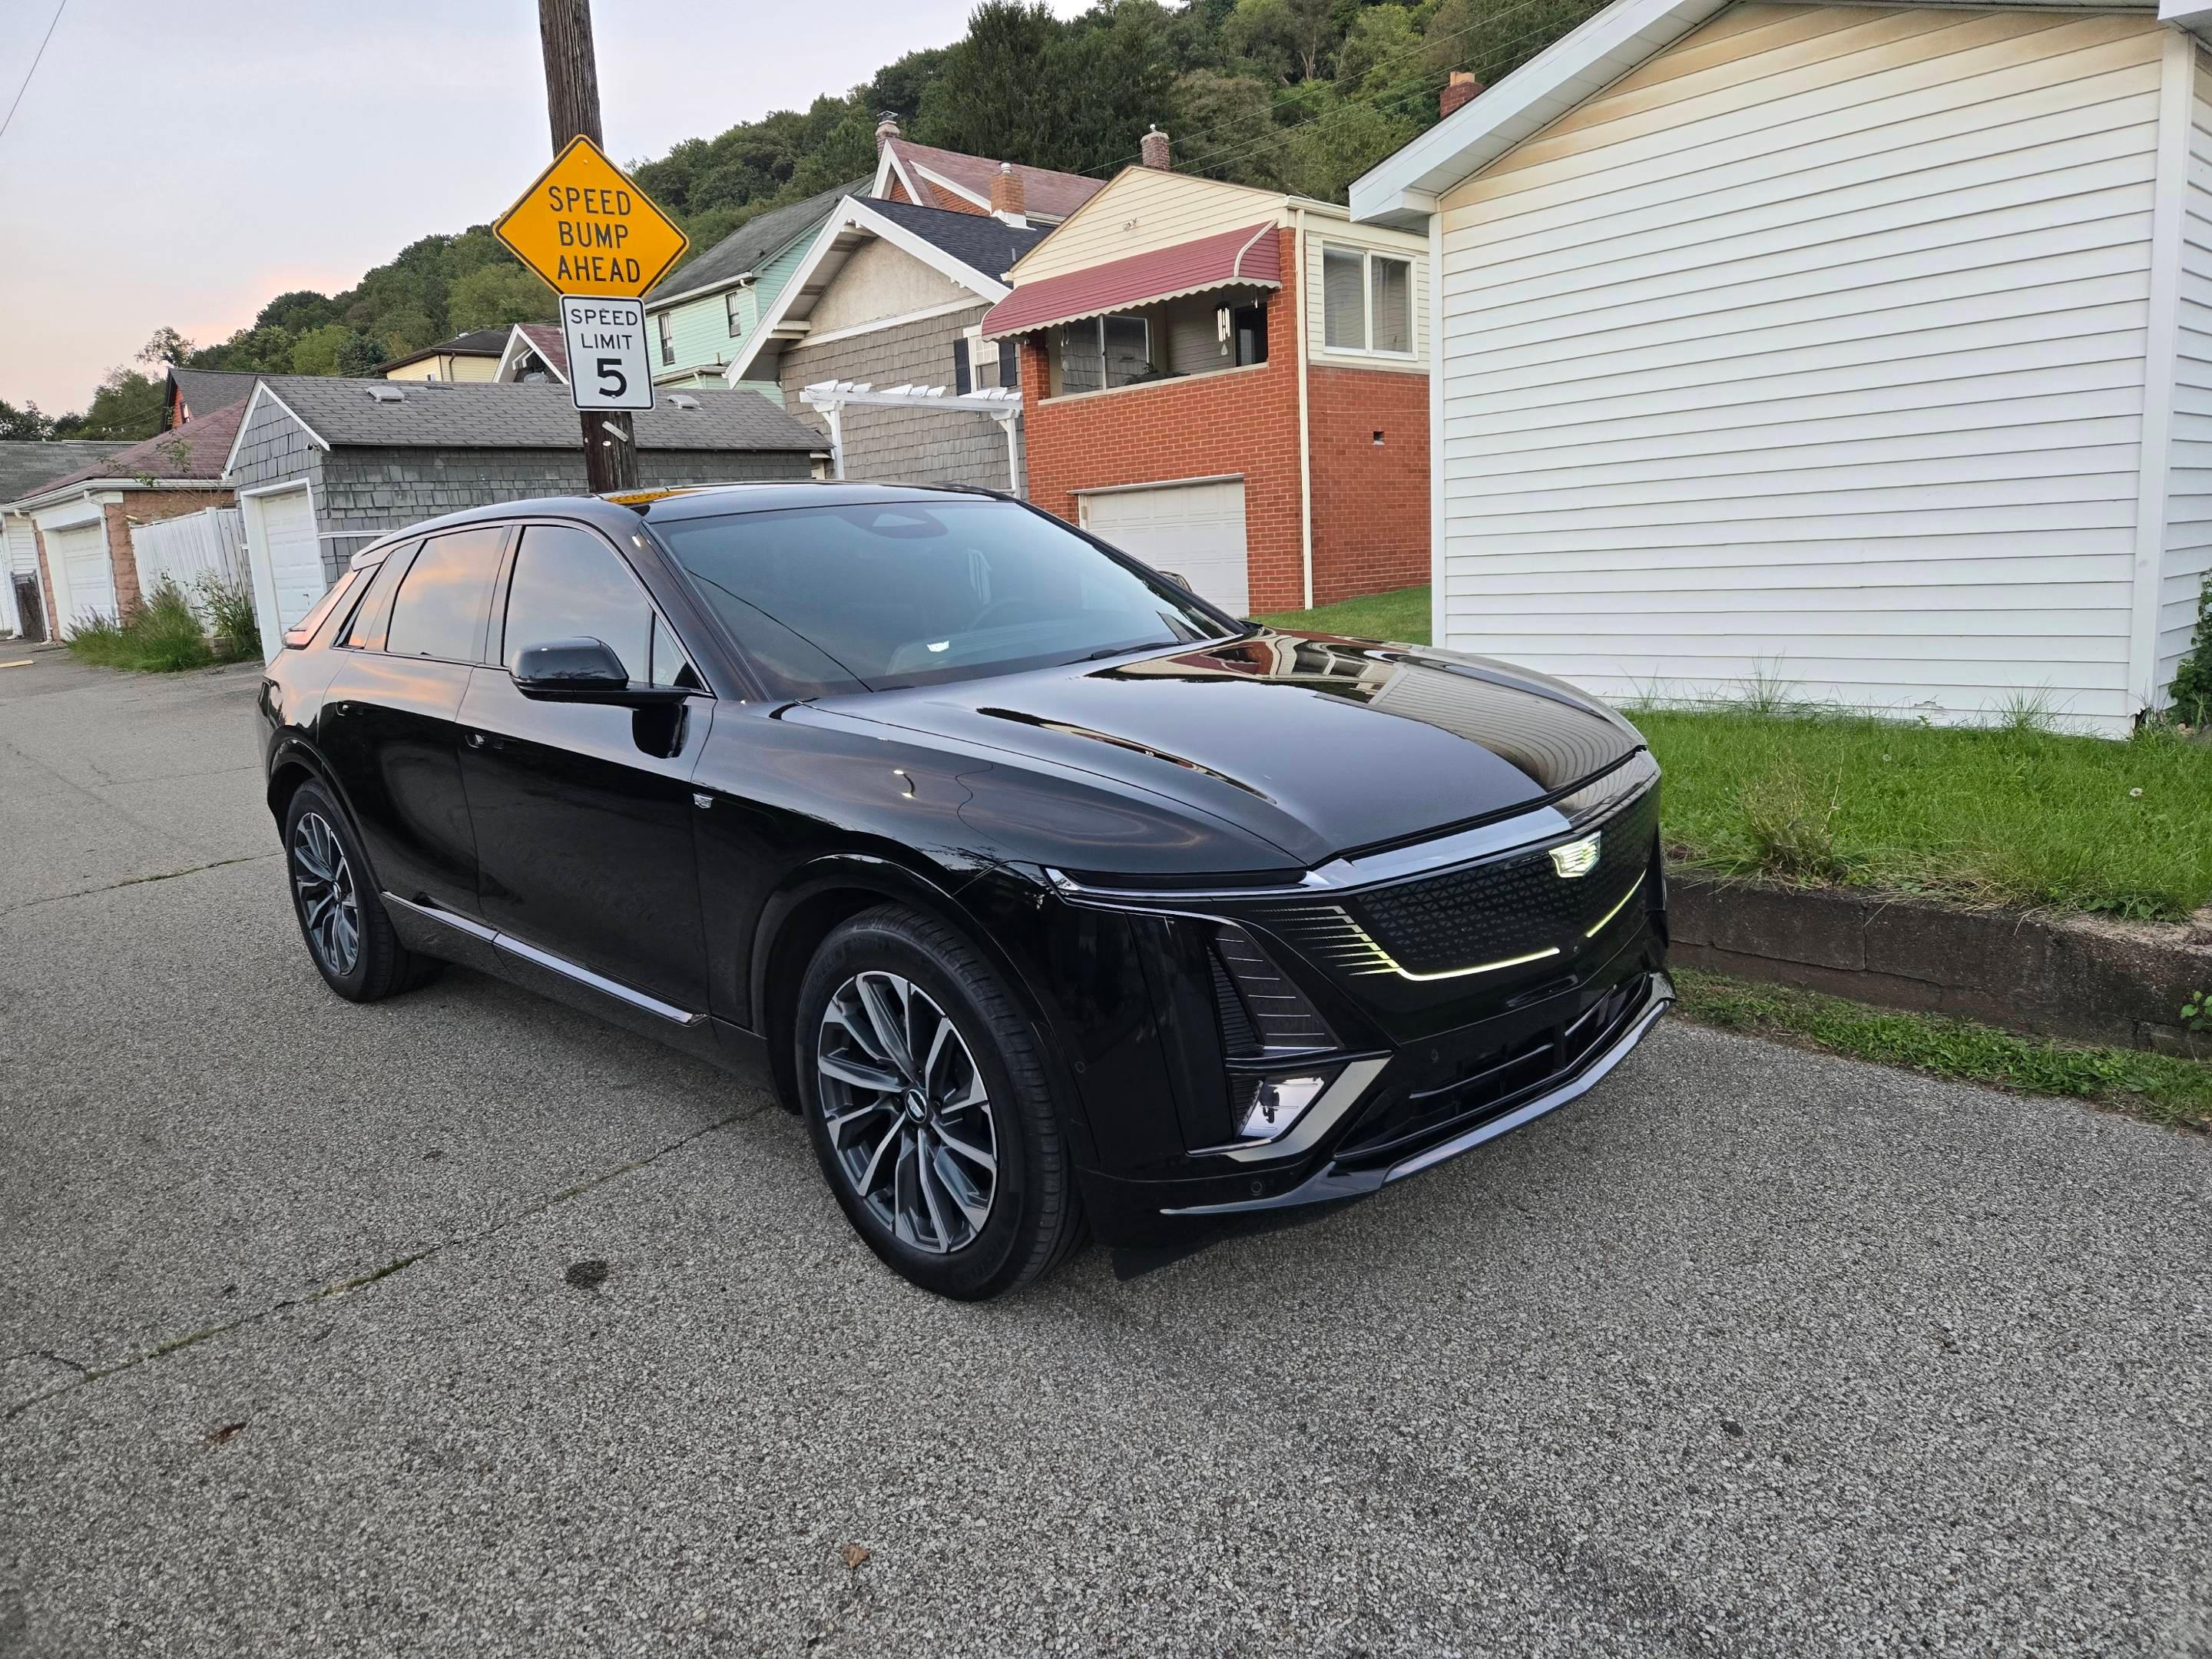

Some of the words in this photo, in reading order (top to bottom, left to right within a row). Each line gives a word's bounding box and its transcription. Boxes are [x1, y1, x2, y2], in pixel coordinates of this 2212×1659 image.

[548, 185, 631, 216] SPEED
[558, 220, 628, 249] BUMP
[557, 255, 641, 283] AHEAD
[571, 308, 638, 326] SPEED
[581, 333, 632, 350] LIMIT
[596, 357, 628, 398] 5
